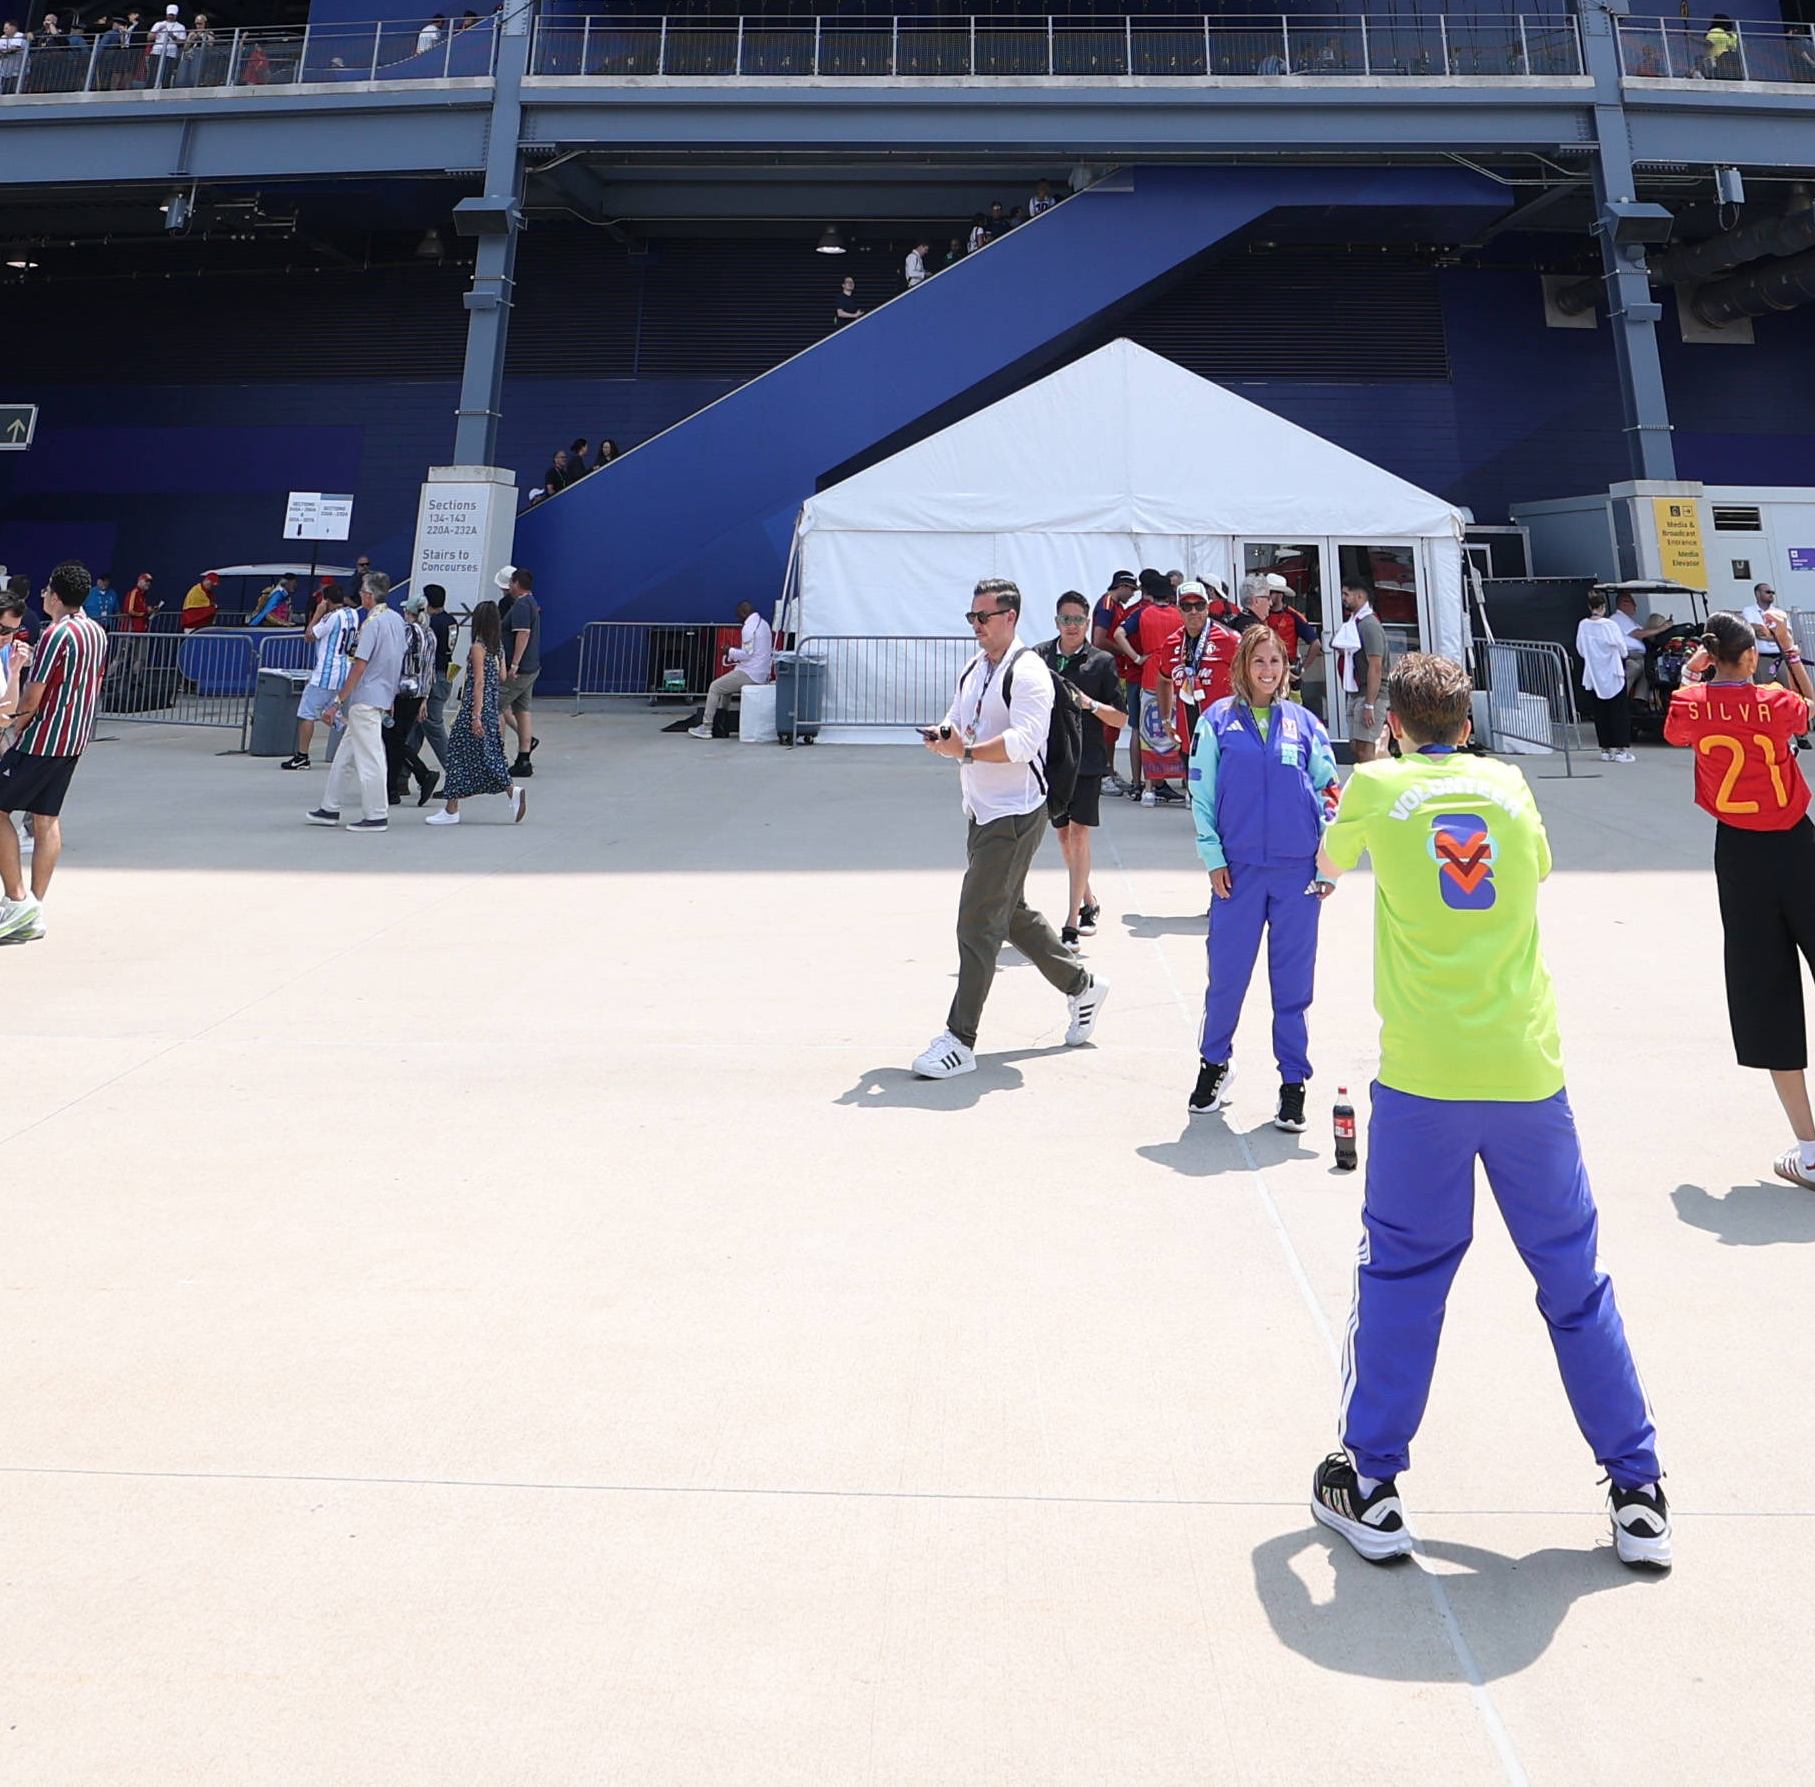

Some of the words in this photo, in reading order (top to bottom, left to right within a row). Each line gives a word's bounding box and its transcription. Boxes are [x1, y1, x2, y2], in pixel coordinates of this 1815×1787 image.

[428, 499, 477, 510] Sections
[429, 514, 466, 523] 134-143
[426, 526, 478, 535] 220A-232A
[1662, 529, 1696, 537] Broadcast
[422, 549, 456, 560] Stairs
[459, 549, 470, 560] to
[421, 562, 478, 572] Concourses
[1672, 559, 1700, 567] Elevator
[1688, 701, 1771, 723] SILVA
[1699, 734, 1788, 814] 21
[1388, 776, 1521, 821] VOLUNTEER
